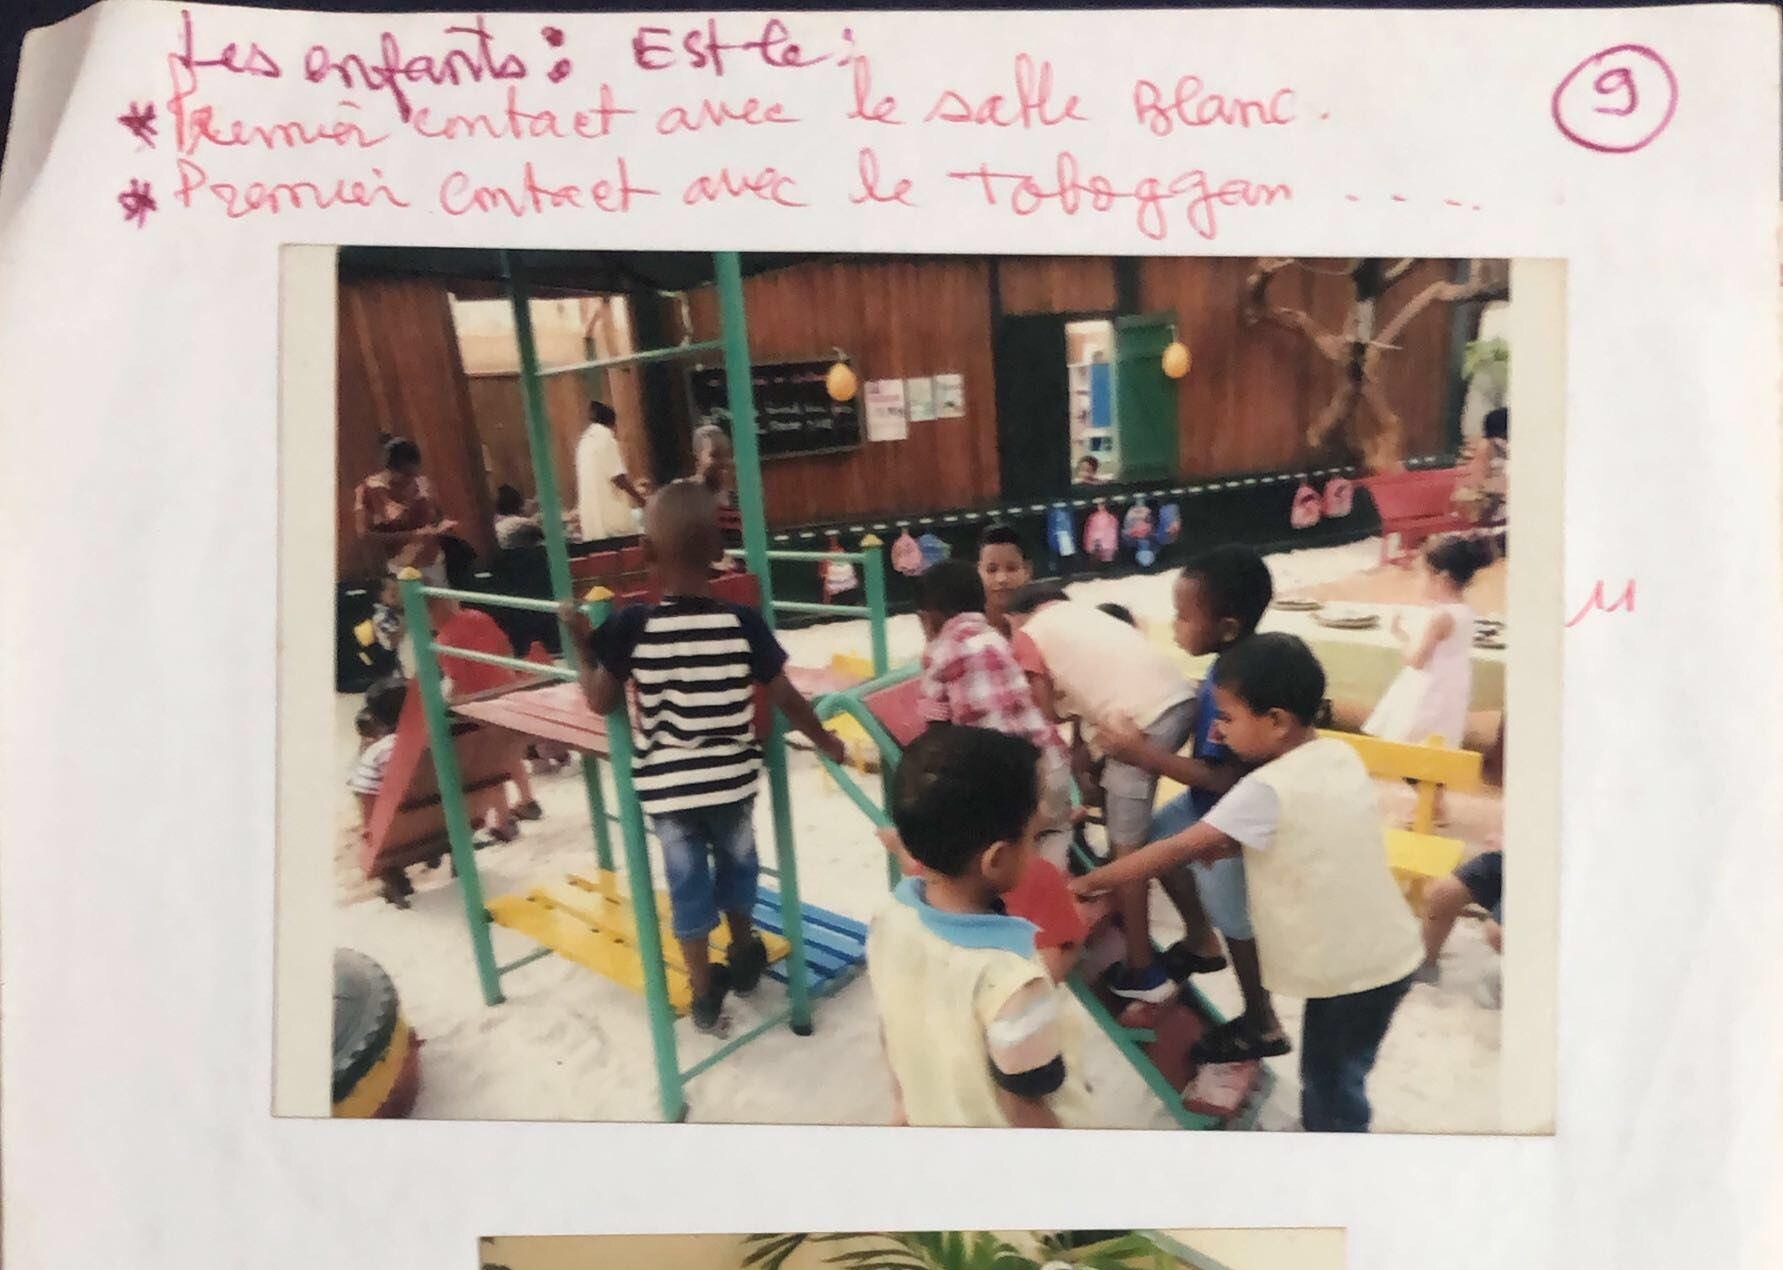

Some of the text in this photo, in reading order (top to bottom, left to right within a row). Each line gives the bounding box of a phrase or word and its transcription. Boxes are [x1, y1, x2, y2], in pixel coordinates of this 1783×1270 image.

[180, 9, 281, 79] Les
[167, 53, 391, 154] Premier
[656, 98, 801, 136] avec
[847, 55, 906, 125] le
[1593, 67, 1636, 116] 9
[175, 158, 410, 218] Premier
[683, 167, 809, 207] avec
[849, 147, 917, 207] le
